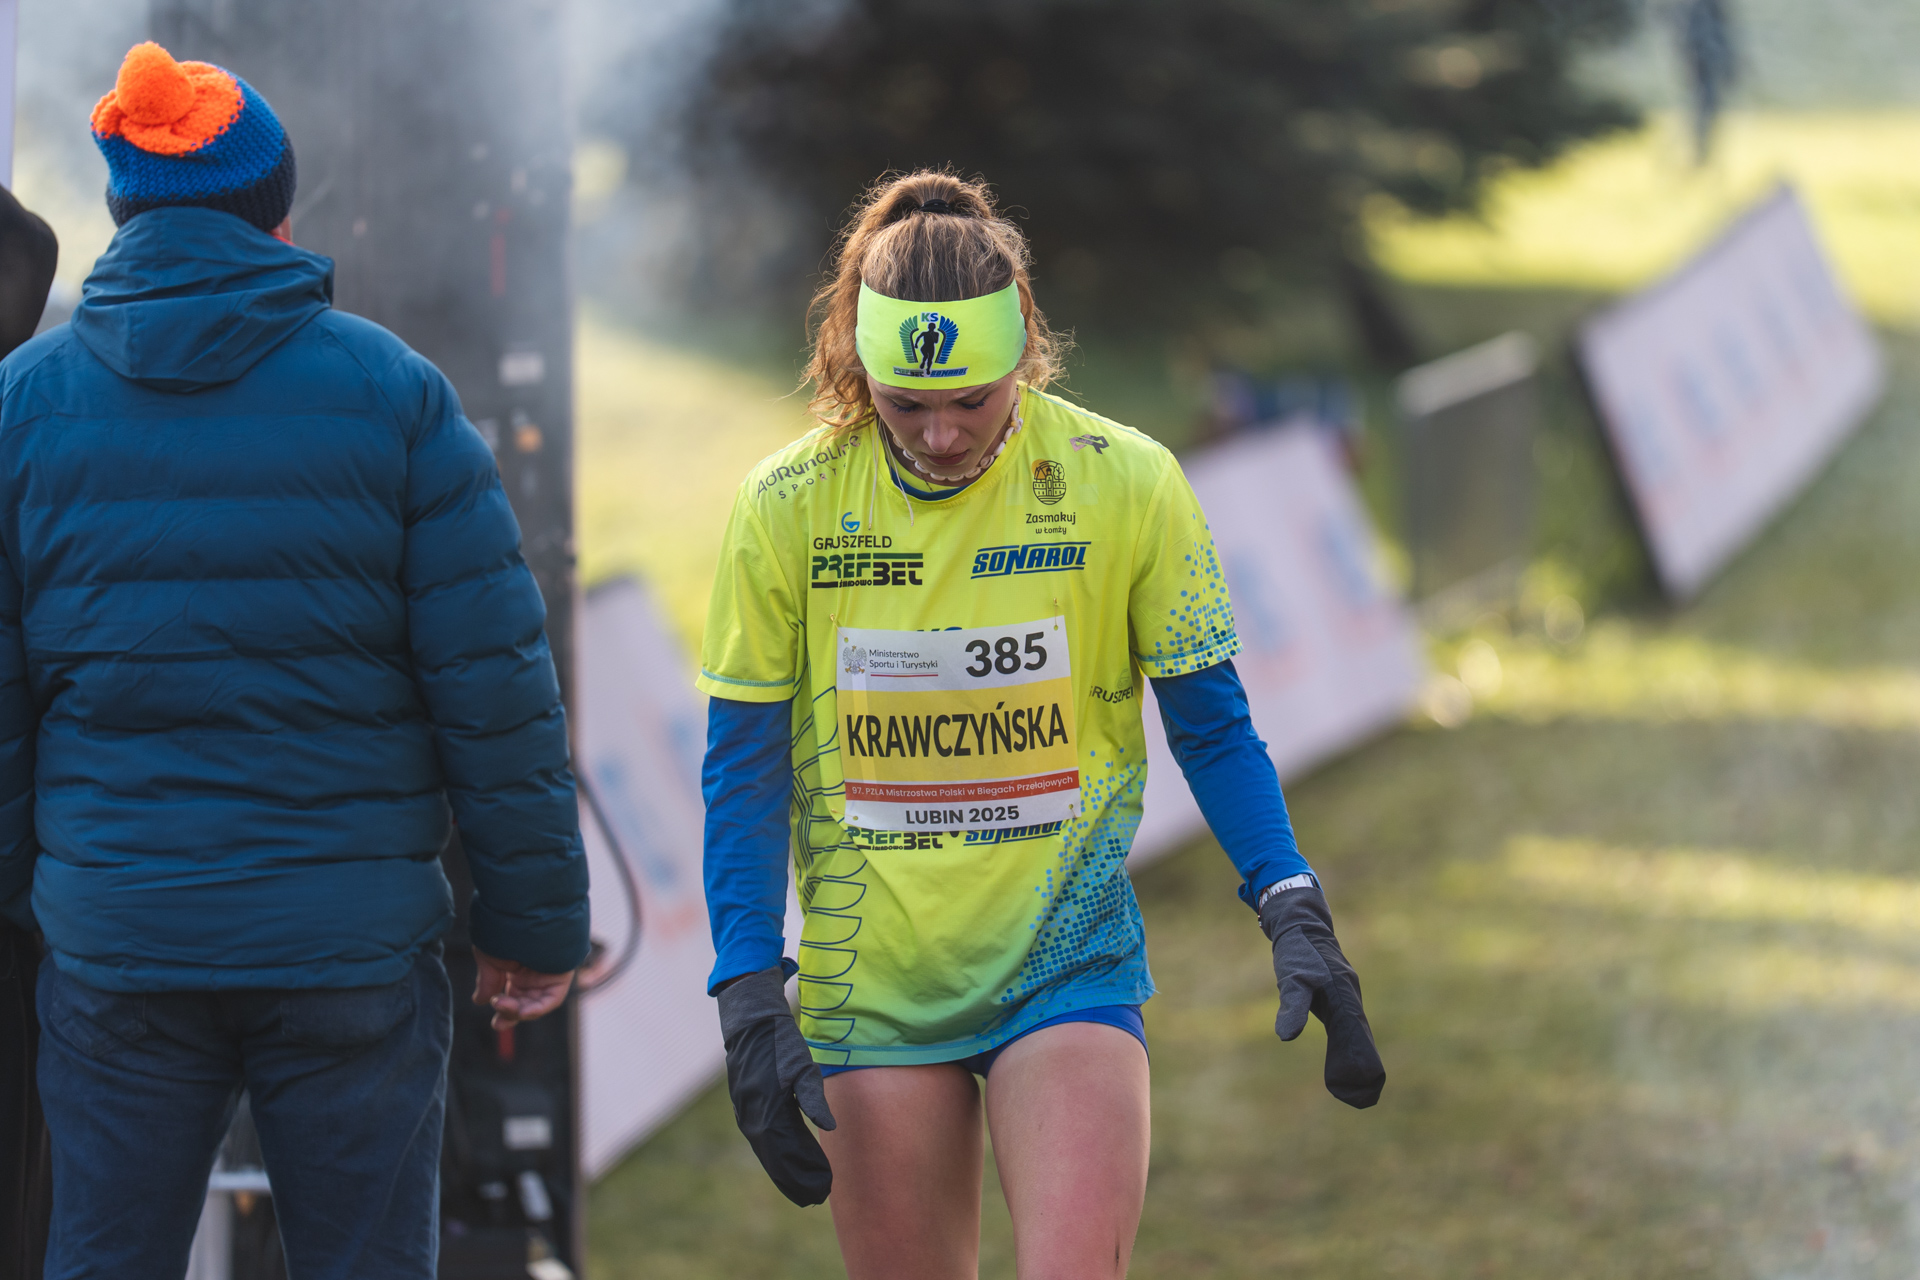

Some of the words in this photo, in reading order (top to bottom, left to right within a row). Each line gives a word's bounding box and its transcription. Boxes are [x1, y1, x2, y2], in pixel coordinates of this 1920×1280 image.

[921, 312, 939, 322] KS
[1025, 511, 1076, 526] Zasmakuj
[813, 535, 892, 550] GRUSZFELD
[970, 542, 1091, 579] SONAROL
[869, 649, 920, 659] Ministerstwo
[965, 631, 1048, 678] 385
[869, 660, 895, 669] Sportu
[901, 660, 938, 669] Turystyki
[846, 701, 1068, 758] KRAWCZYŃSKA
[851, 786, 864, 795] 97.
[865, 787, 884, 796] PZLA
[886, 788, 937, 797] Mistrzostwa
[939, 787, 965, 797] Polski
[967, 788, 975, 796] w
[977, 785, 1015, 796] Biegach
[1016, 775, 1073, 791] Przełajowych
[905, 809, 963, 824] LUBIN
[969, 805, 1020, 822] 2025
